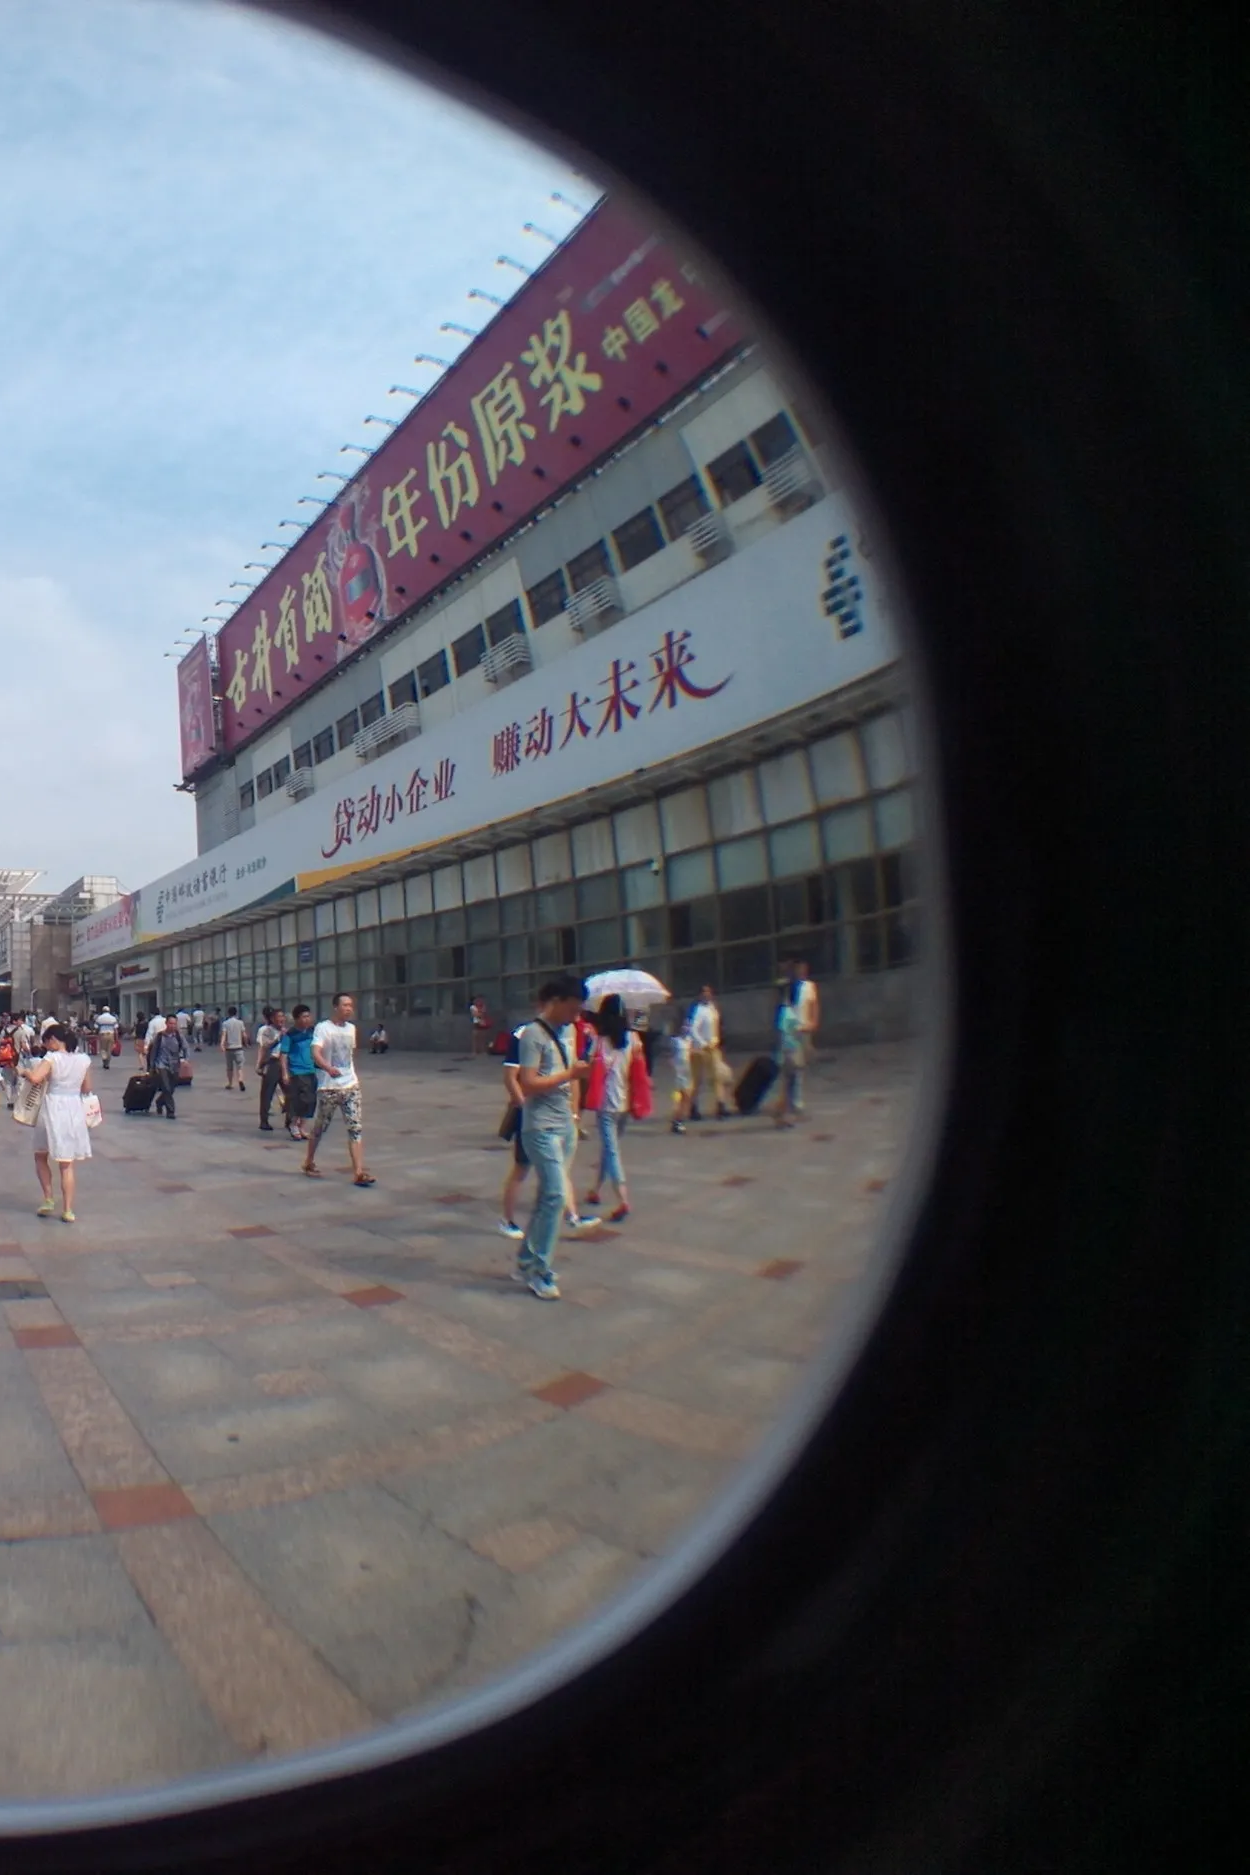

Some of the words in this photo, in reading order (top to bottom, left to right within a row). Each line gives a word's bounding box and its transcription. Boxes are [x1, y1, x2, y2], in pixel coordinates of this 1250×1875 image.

[382, 309, 603, 559] 年份原浆
[321, 757, 457, 860] 贷动小企业
[491, 628, 735, 779] 赚动大未来
